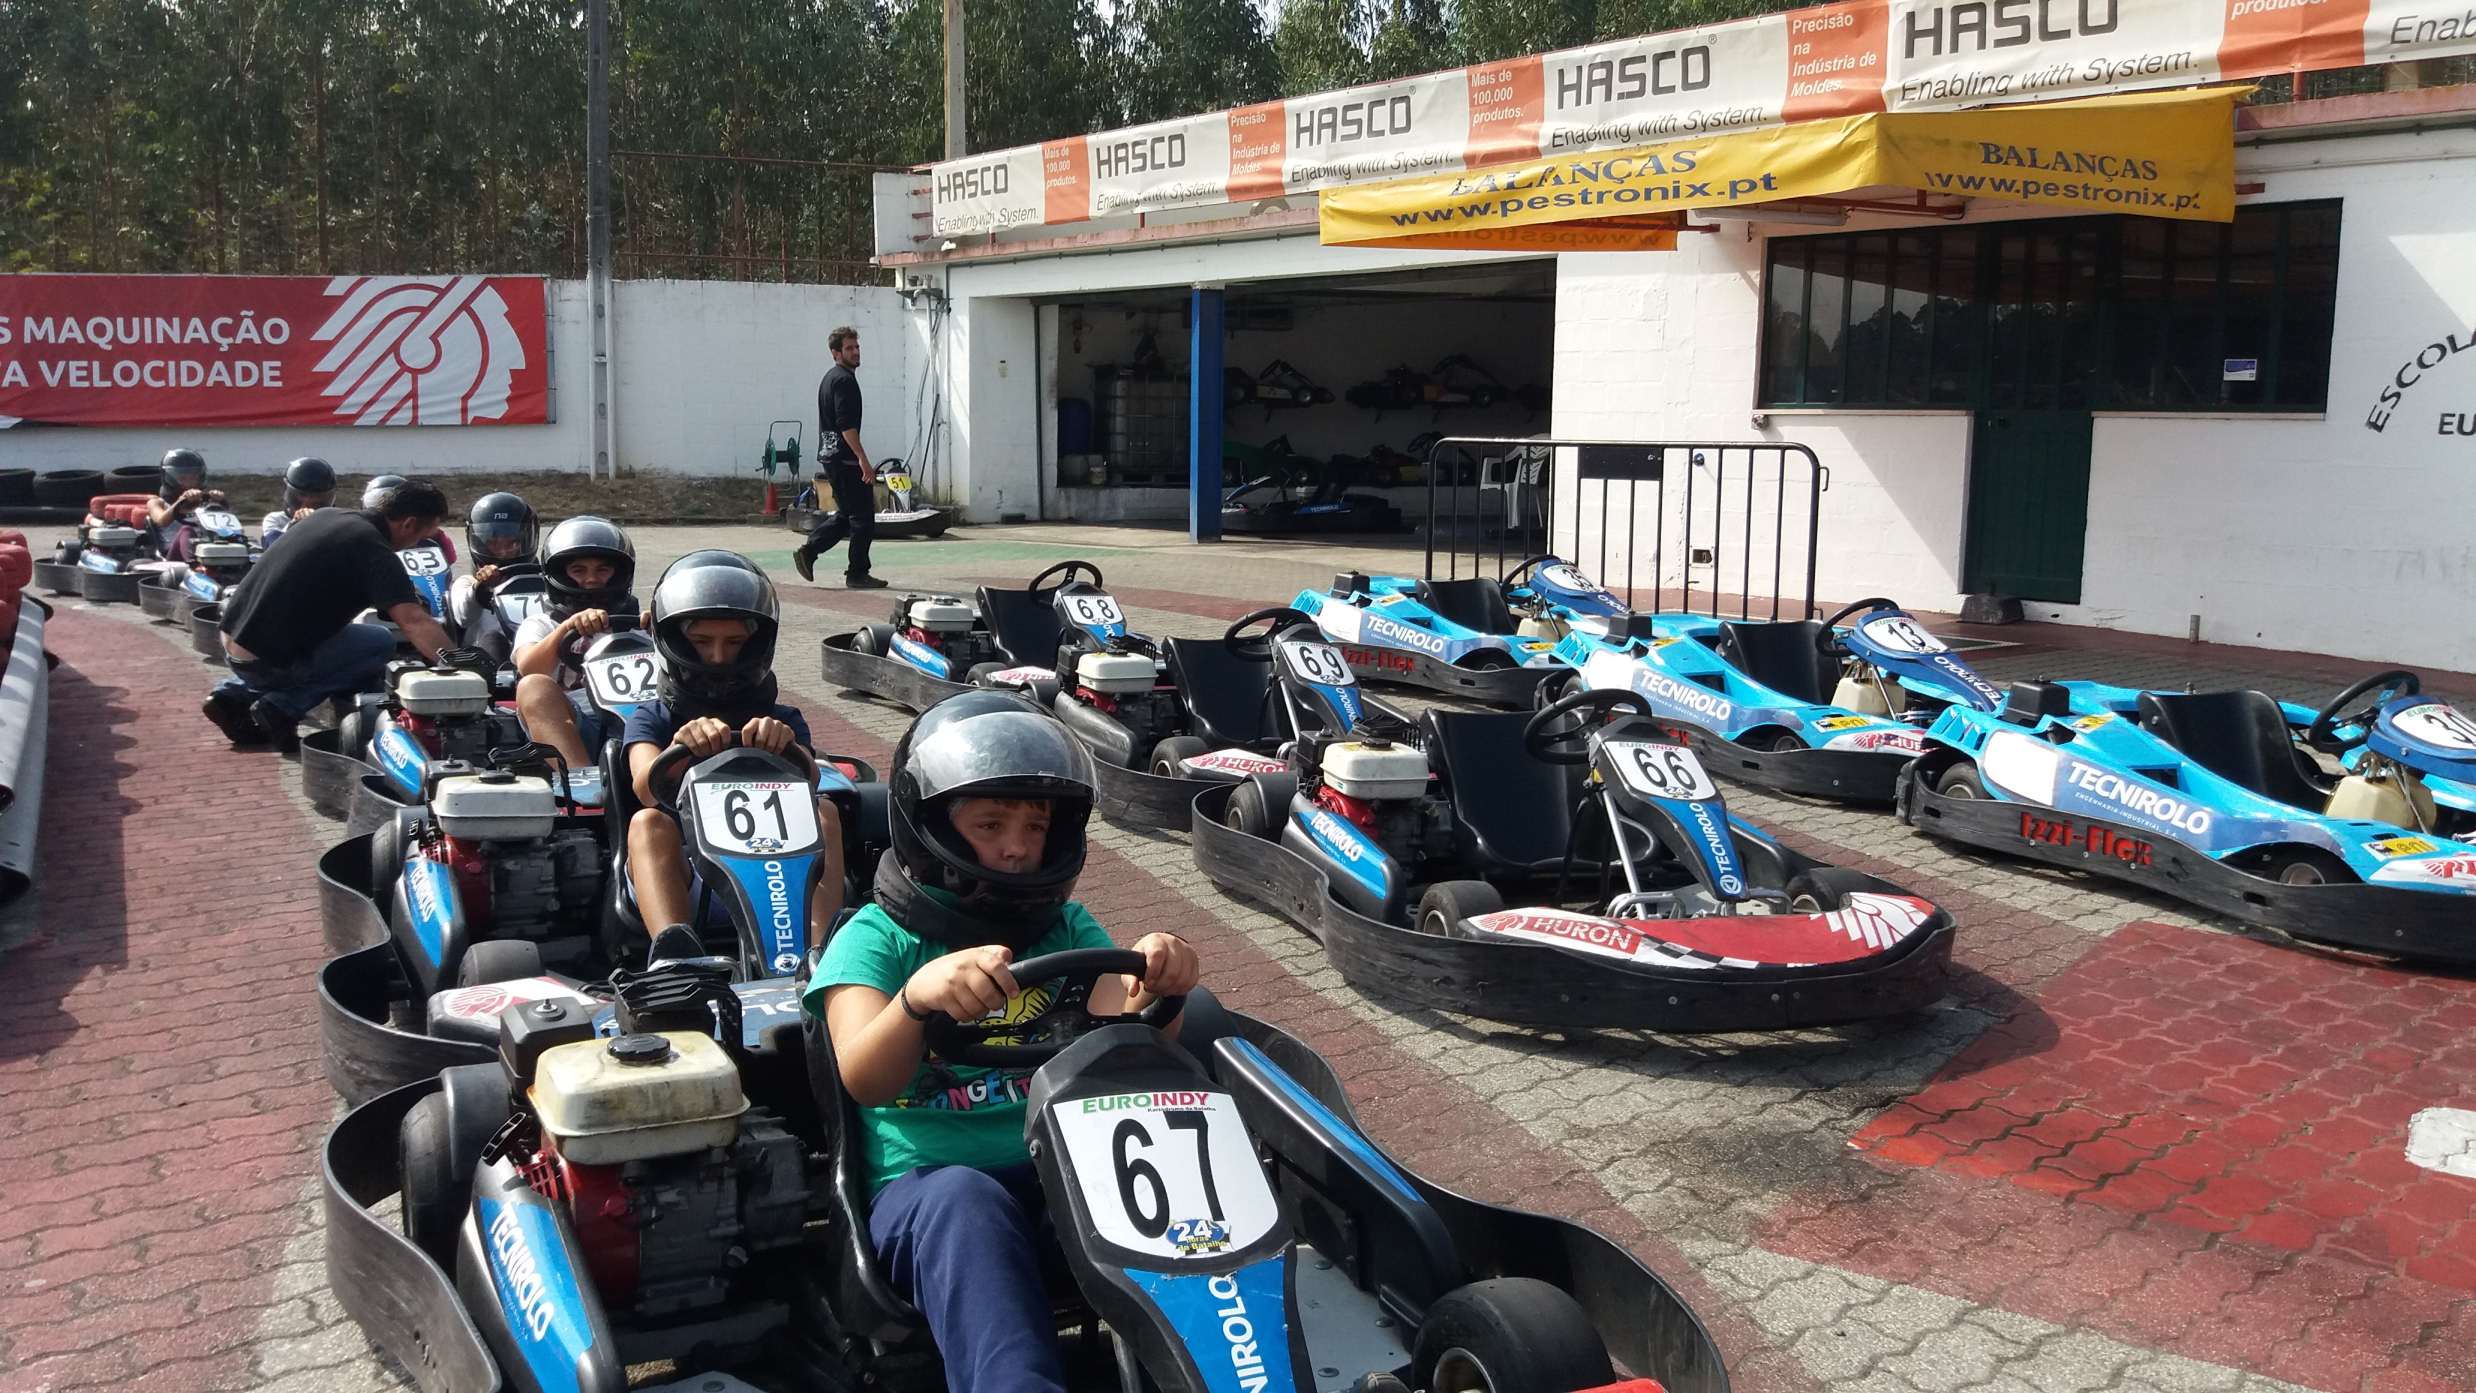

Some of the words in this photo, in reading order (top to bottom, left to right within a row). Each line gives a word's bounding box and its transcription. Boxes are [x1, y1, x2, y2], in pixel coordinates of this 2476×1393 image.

[1792, 14, 1854, 35] Precisão
[1903, 0, 2118, 59] HASCO
[1793, 43, 1810, 57] na
[1793, 57, 1857, 77] Indústria
[1859, 51, 1877, 67] de
[1471, 73, 1496, 88] Mais
[1498, 69, 1512, 82] de
[1557, 45, 1711, 110] HASCO
[1901, 72, 2013, 102] Enabling
[2021, 63, 2074, 88] with
[2083, 51, 2198, 84] System.
[1231, 113, 1266, 128] Precisão
[1295, 95, 1412, 149] HASCO
[1472, 108, 1524, 127] produtos.
[1552, 122, 1631, 149] Enabling
[1638, 114, 1677, 136] with
[1683, 106, 1767, 132] System.
[1061, 145, 1069, 156] de
[1232, 134, 1242, 143] na
[1233, 143, 1268, 160] Indústria
[1270, 142, 1281, 154] de
[1096, 133, 1186, 179] HASCO
[1356, 155, 1385, 174] with
[1980, 142, 2158, 182] BALANÇAS
[938, 163, 1008, 204] HASCO
[1391, 172, 1777, 226] www.pestronix.pt
[938, 215, 978, 232] Enabling
[1000, 207, 1038, 224] System.
[24, 310, 290, 351] MAQUINAÇÃO
[0, 360, 29, 388] A
[38, 360, 283, 388] VELOCIDADE
[2365, 328, 2476, 432] ESCOL
[891, 477, 906, 489] 51
[207, 514, 235, 528] 72
[403, 551, 440, 571] 63
[1077, 599, 1115, 619] 68
[1367, 616, 1444, 653] TECNIROLO
[1888, 622, 1926, 650] 13
[607, 658, 657, 695] 62
[1299, 646, 1344, 679] 69
[1640, 670, 1731, 720] TECNIROLO
[1225, 759, 1286, 774] HURO
[1633, 748, 1696, 790] 66
[2068, 762, 2210, 834] TECNIROLO
[724, 790, 788, 840] 61
[1689, 803, 1732, 873] TECNIROLO
[765, 861, 795, 951] TECNIROLO
[1534, 917, 1631, 950] HURON
[1082, 1092, 1209, 1114] EUROINDY
[1112, 1111, 1225, 1239] 67
[1173, 1220, 1212, 1242] 24
[491, 1201, 554, 1342] TECNIROLO
